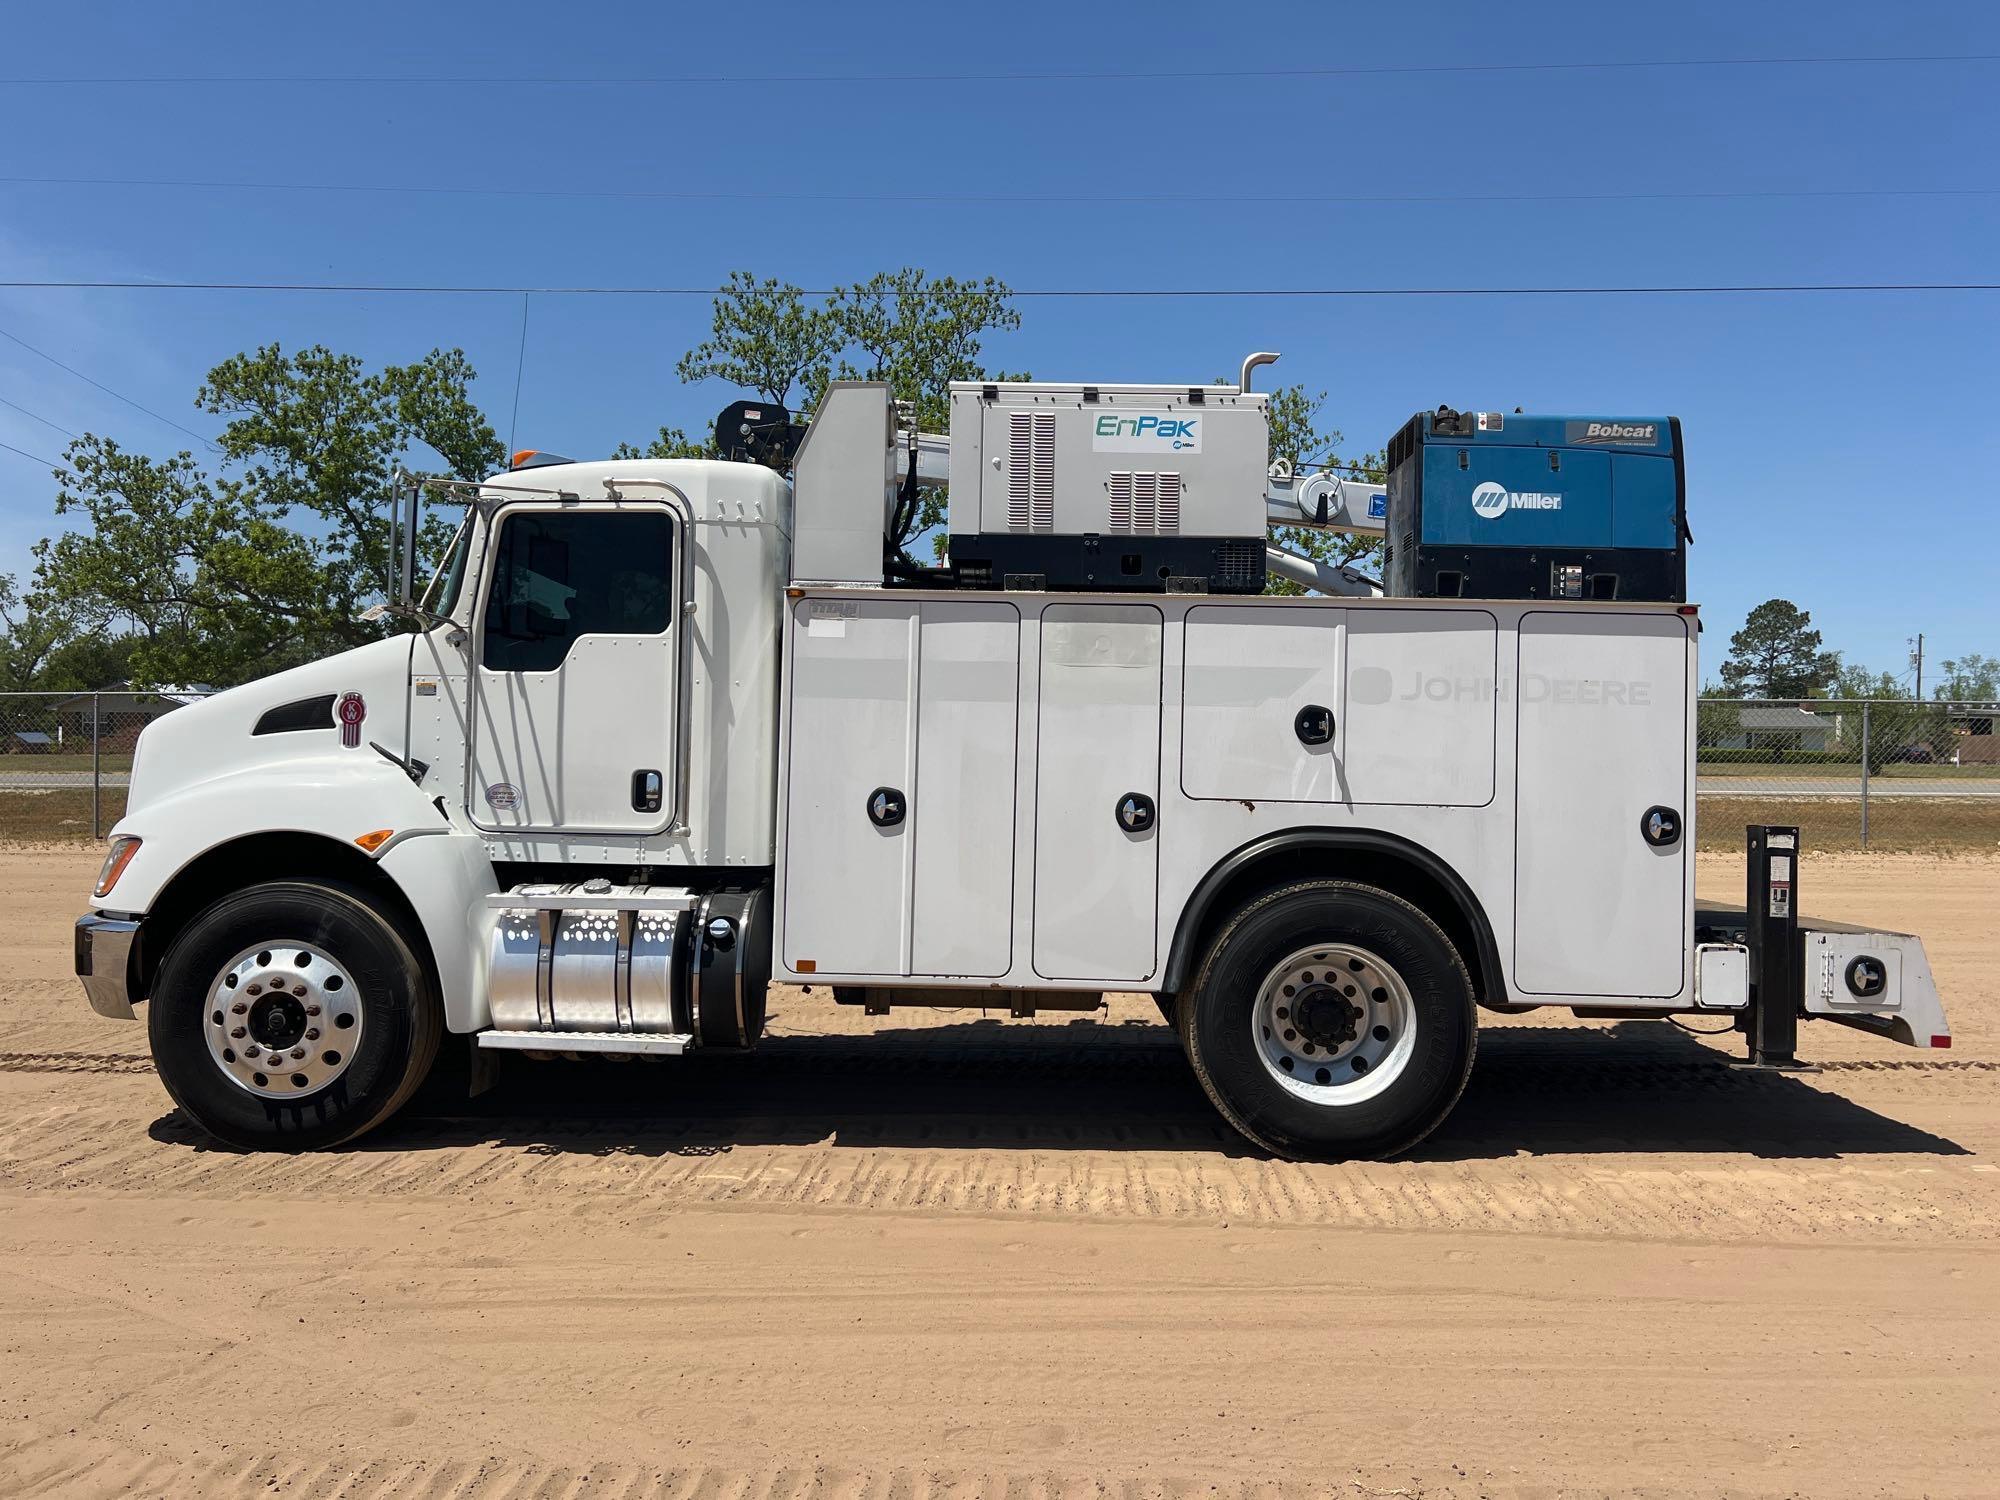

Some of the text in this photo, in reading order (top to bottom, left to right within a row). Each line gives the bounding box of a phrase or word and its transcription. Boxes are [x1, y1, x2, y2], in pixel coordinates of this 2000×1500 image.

[1096, 415, 1198, 438] EnPak
[1586, 423, 1655, 438] Bobcat
[1511, 492, 1561, 509] Miller
[1400, 671, 1652, 705] JOHN DEERE
